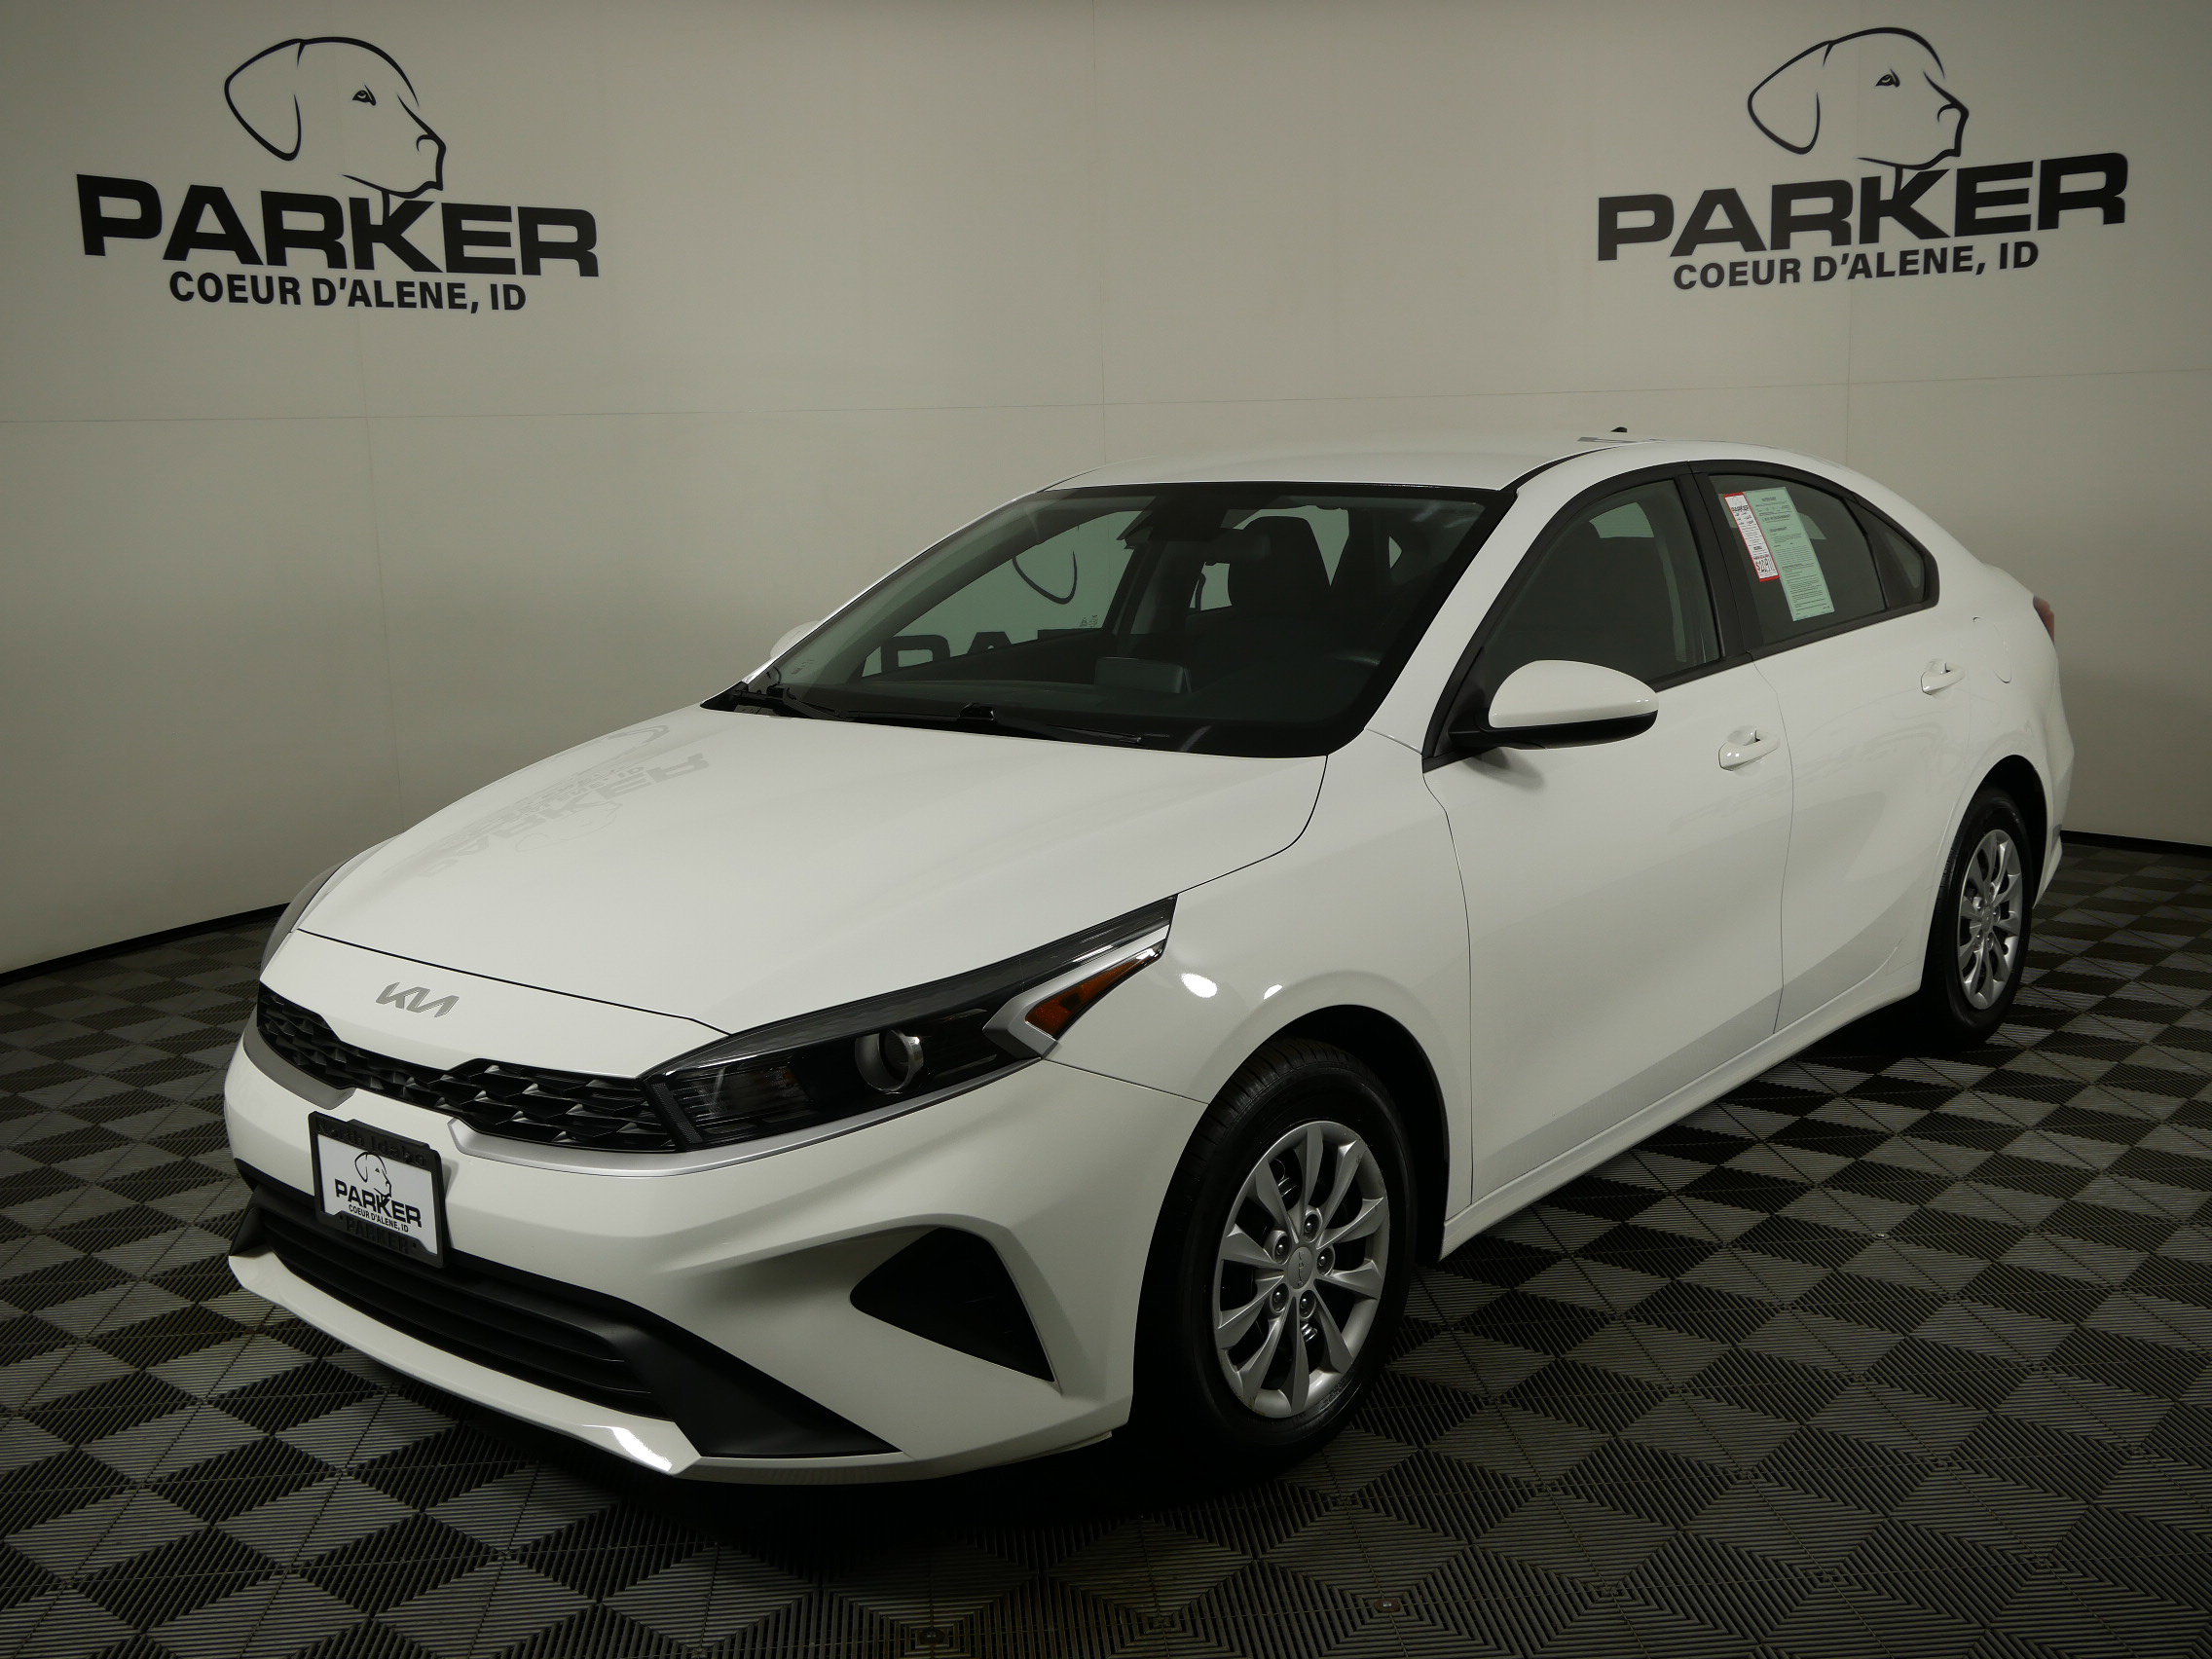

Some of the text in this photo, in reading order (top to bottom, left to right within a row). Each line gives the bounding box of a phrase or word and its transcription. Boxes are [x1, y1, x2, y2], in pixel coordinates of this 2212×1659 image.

[76, 173, 599, 276] PARKER
[1598, 152, 2127, 261] PARKER
[1673, 240, 2040, 290] COEUR D'ALENE, ID
[168, 270, 527, 313] COEUR D'ALENE, ID
[375, 981, 461, 1018] KIA
[334, 1178, 423, 1229] PARKER
[349, 1203, 410, 1233] COEUR D'ALENE, ID
